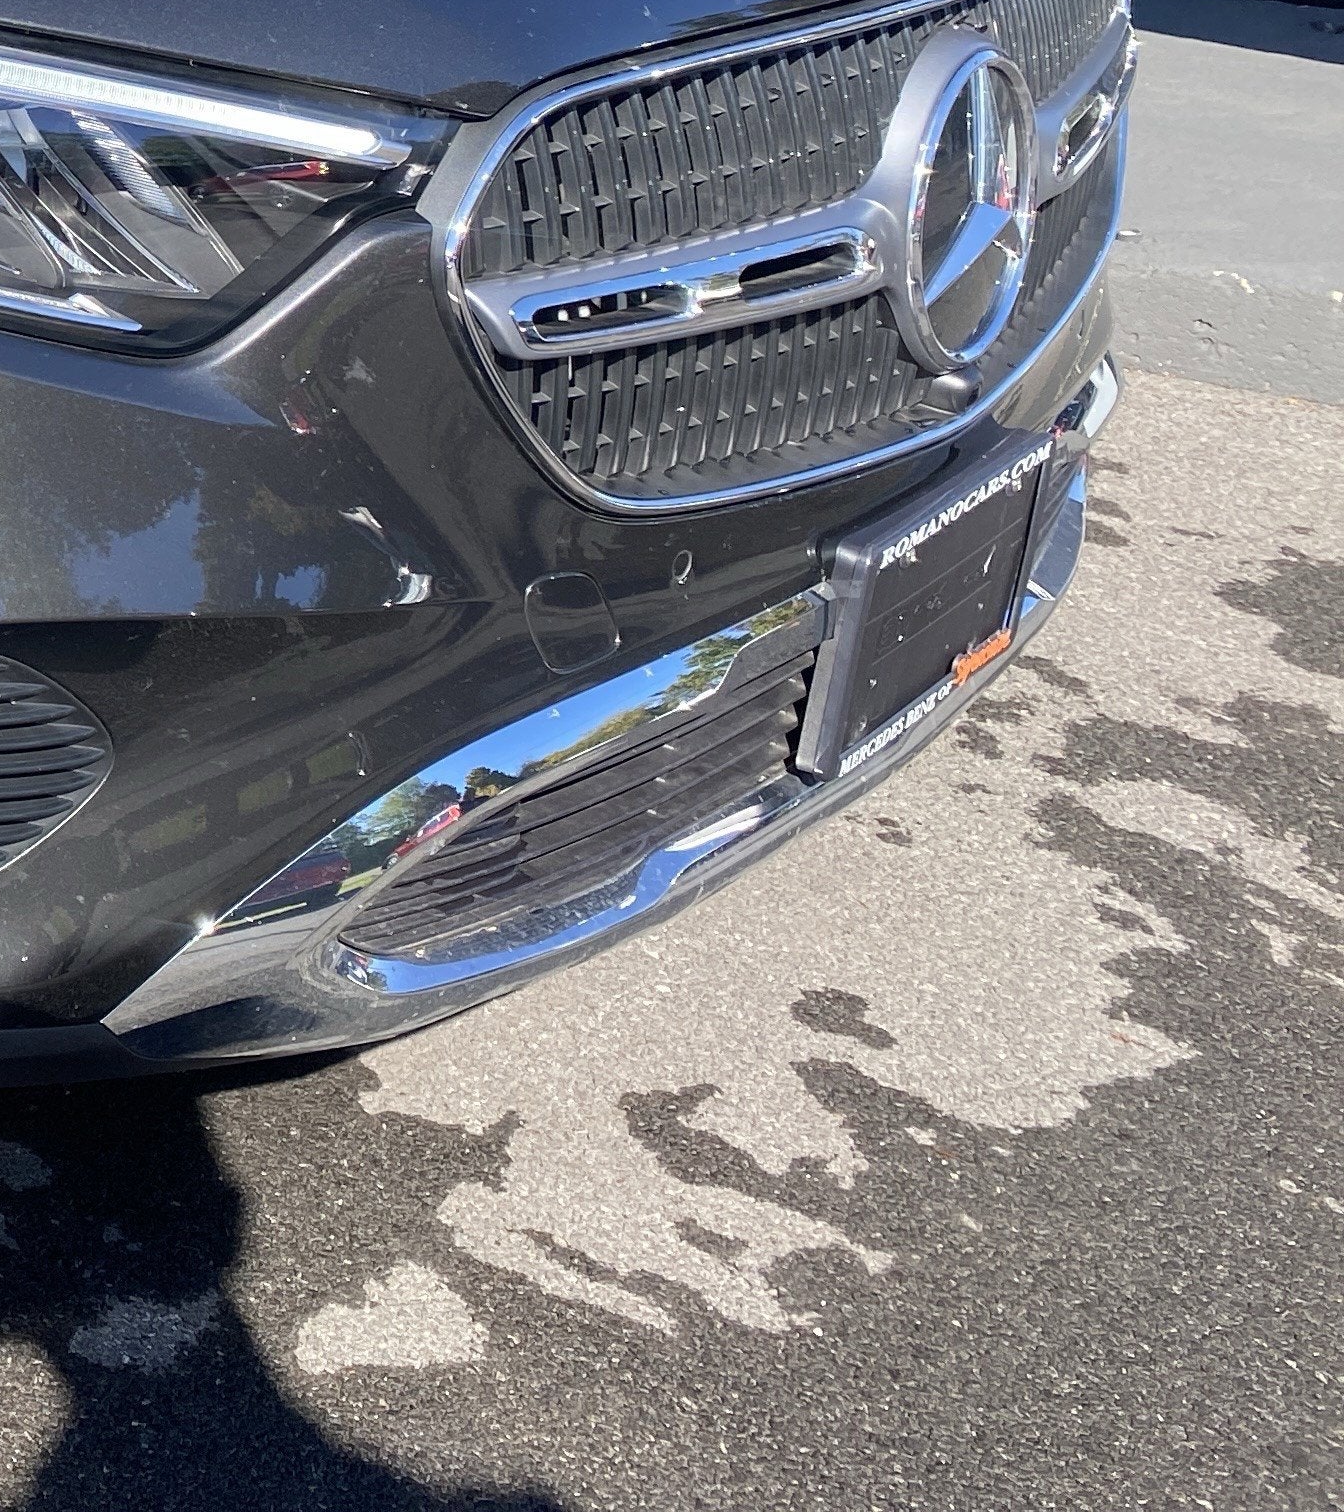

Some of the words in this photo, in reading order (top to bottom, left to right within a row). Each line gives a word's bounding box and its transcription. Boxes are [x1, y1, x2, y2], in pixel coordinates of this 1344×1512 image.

[878, 441, 1053, 571] ROMANOCARS.COM
[837, 720, 904, 779] MERCEDES
[903, 692, 937, 729] BENZ
